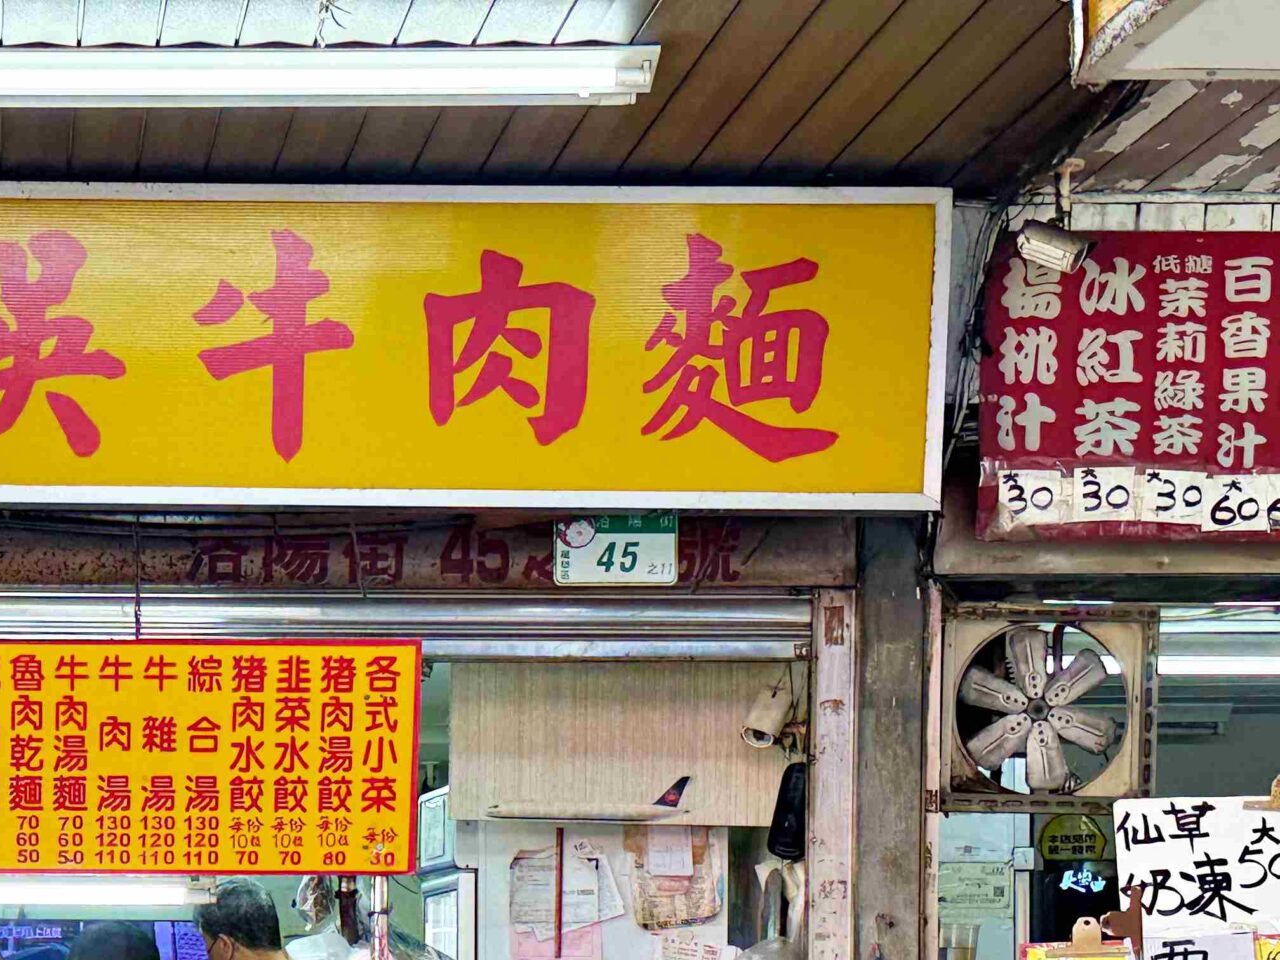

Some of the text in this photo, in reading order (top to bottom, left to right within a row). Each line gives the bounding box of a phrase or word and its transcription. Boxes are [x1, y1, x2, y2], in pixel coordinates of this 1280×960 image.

[1153, 255, 1212, 274] 低糖
[1074, 257, 1146, 456] 冰紅茶
[1153, 277, 1209, 455] 茉莉綠茶
[1217, 256, 1273, 469] 百香果汁
[1008, 481, 1053, 515] 30
[1083, 479, 1130, 511] 30
[1157, 479, 1203, 511] 30
[1210, 495, 1260, 525] 60
[596, 541, 640, 573] 45
[9, 654, 45, 811] 魯肉乾麵
[53, 654, 88, 811] 牛肉湯麵
[97, 655, 133, 812] 牛肉湯
[141, 655, 178, 812] 牛雜湯
[185, 655, 223, 812] 綜合湯
[273, 655, 311, 813] 韭菜水餃
[361, 656, 401, 813] 各式小菜
[16, 815, 39, 830] 70
[58, 816, 83, 831] 70
[96, 815, 131, 830] 130
[138, 816, 175, 830] 130
[184, 816, 219, 830] 130
[16, 832, 39, 847] 60
[58, 833, 83, 847] 60
[96, 832, 131, 847] 120
[138, 833, 175, 847] 120
[184, 833, 219, 847] 120
[1116, 802, 1216, 854] 仙草
[1250, 816, 1280, 845] 大
[16, 849, 39, 864] 50
[58, 850, 83, 865] 50
[96, 850, 131, 864] 110
[138, 850, 175, 864] 110
[184, 850, 219, 864] 110
[235, 851, 259, 865] 70
[279, 851, 302, 865] 70
[322, 851, 346, 865] 80
